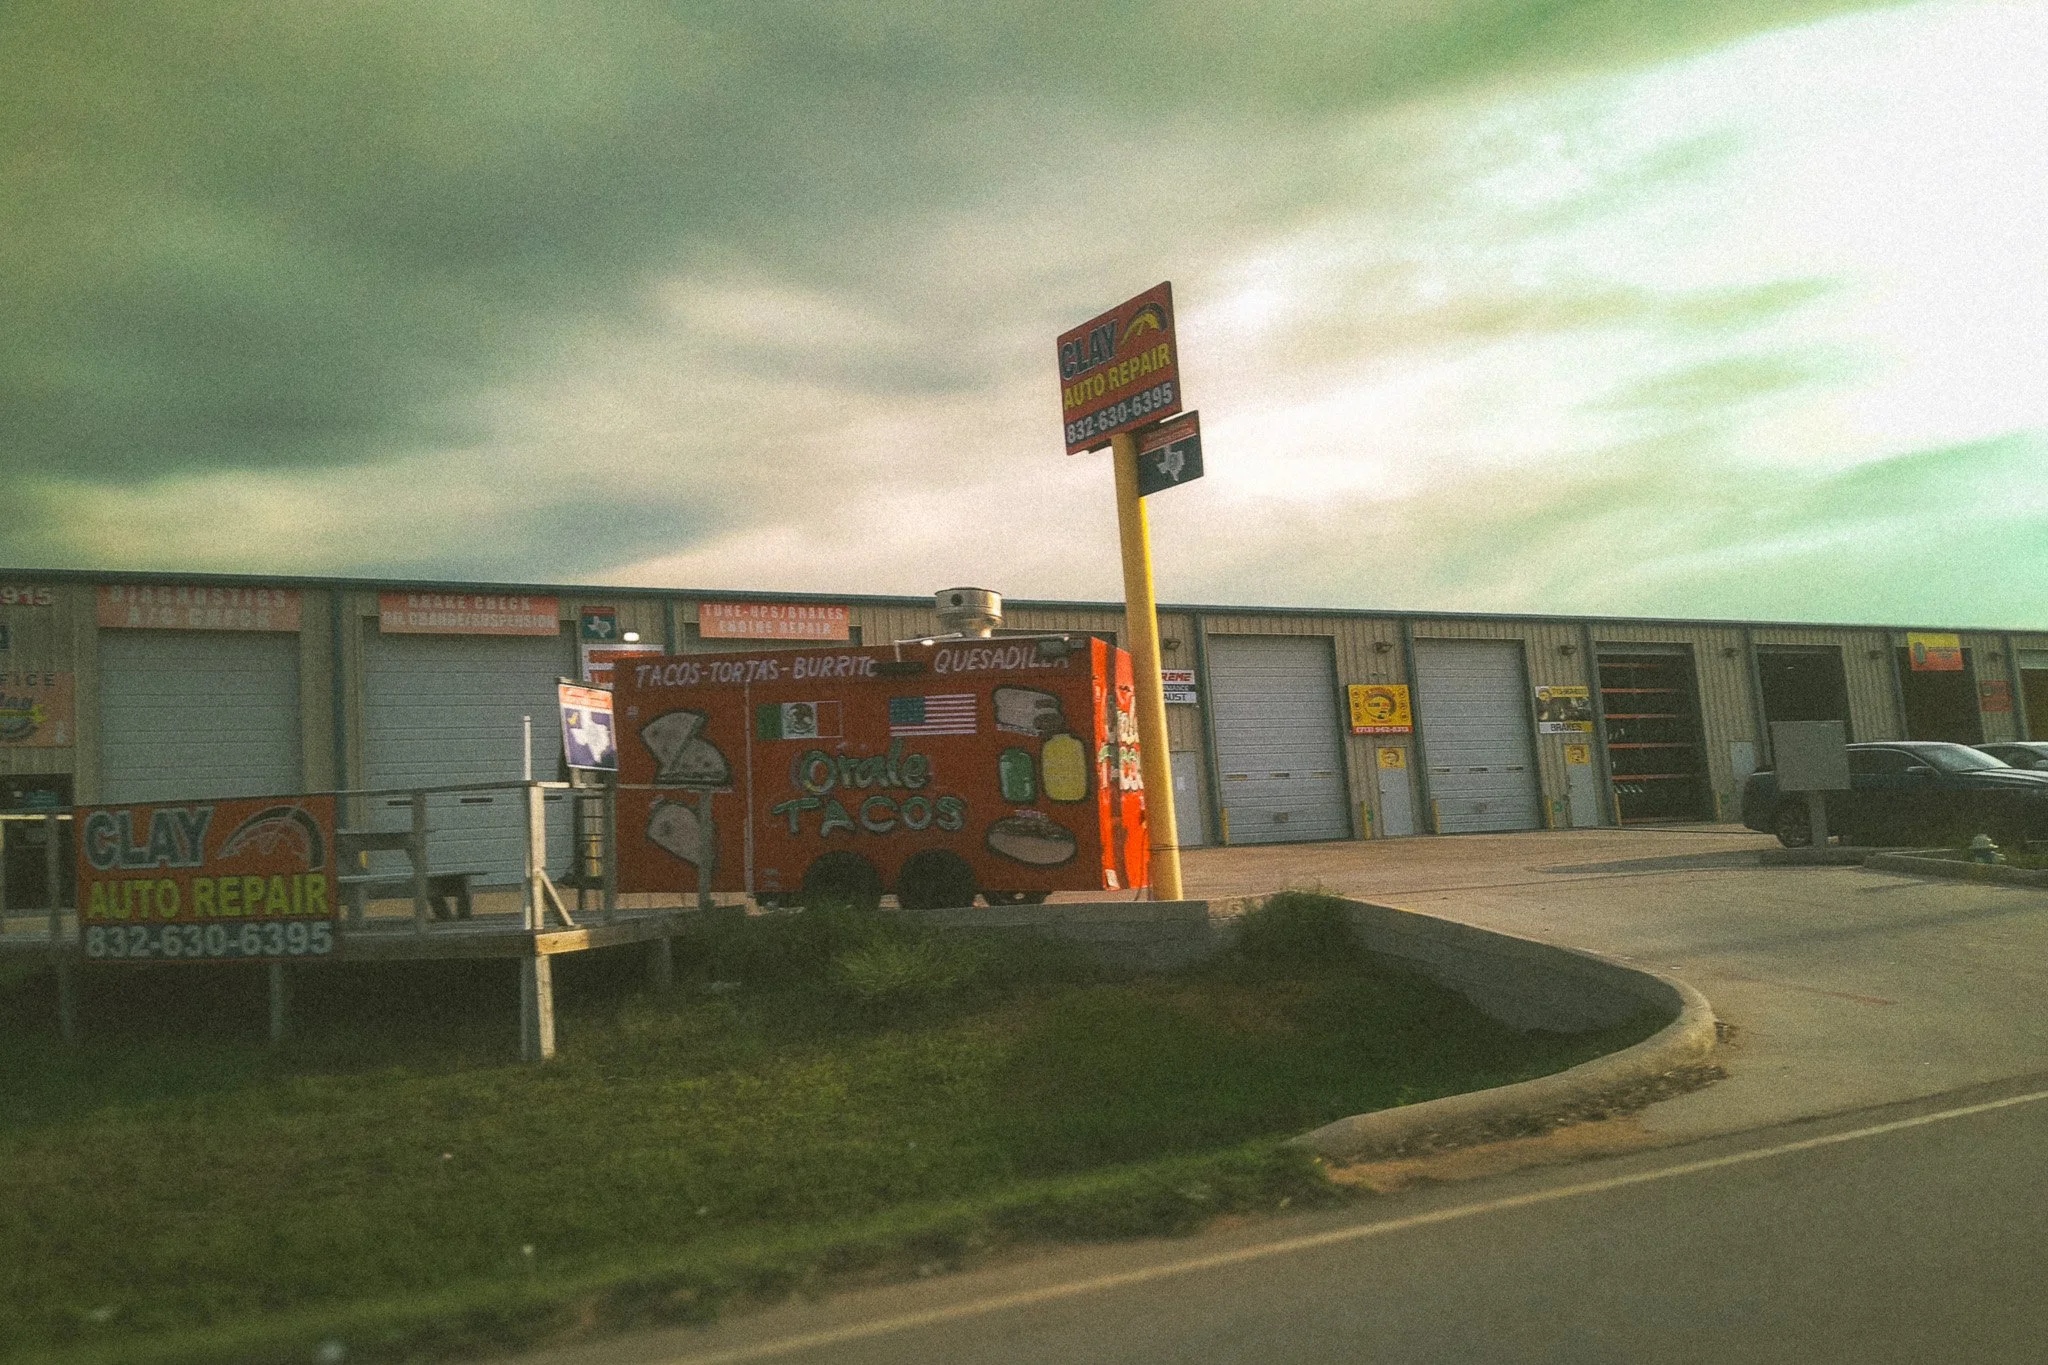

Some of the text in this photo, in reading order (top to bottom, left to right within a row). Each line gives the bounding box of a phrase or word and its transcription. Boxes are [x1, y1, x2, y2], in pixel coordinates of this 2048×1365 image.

[1060, 319, 1118, 381] CLAY
[1064, 343, 1171, 410] AUTO REPAIR
[1067, 383, 1174, 443] 832-630-6395
[83, 805, 216, 872] CLAY
[770, 796, 966, 838] TACOS
[88, 873, 329, 920] AUTO REPAIR
[85, 921, 333, 958] 832-630-6395
